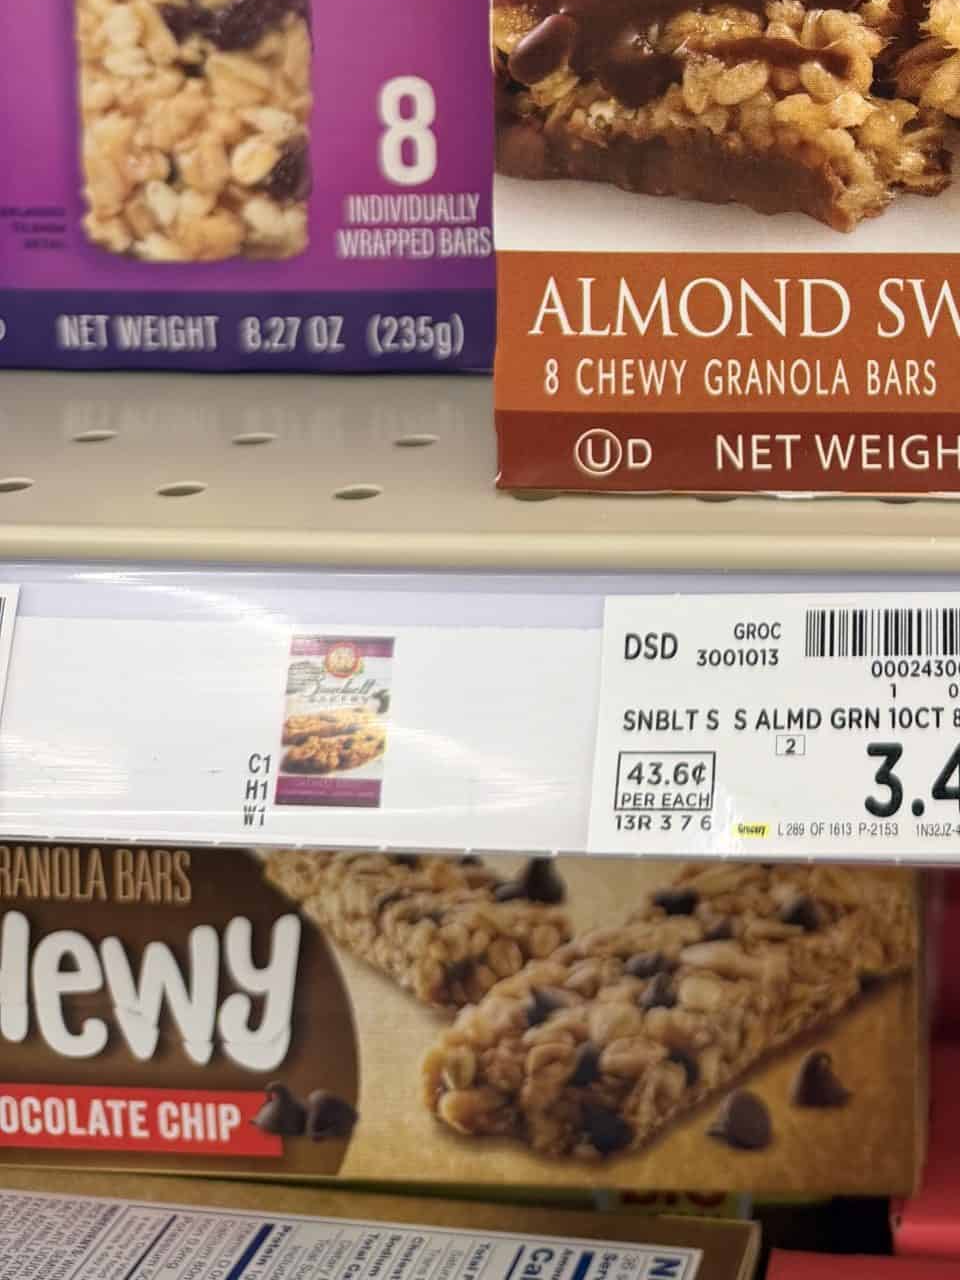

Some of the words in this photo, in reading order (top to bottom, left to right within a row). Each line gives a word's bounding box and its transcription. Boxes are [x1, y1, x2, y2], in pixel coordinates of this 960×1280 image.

[377, 75, 438, 187] 8
[348, 194, 481, 225] INDIVIDUALLY
[338, 228, 436, 257] WRAPPED
[440, 228, 492, 257] BARS
[528, 276, 852, 339] ALMOND
[57, 314, 109, 350] NET
[116, 314, 219, 353] WEIGHT
[241, 316, 303, 354] 8.27
[310, 317, 346, 353] OZ
[369, 315, 465, 357] (235g)
[544, 358, 560, 396] 8
[576, 358, 688, 396] CHEWY
[704, 358, 850, 396] GRANOLA
[866, 359, 938, 396] BARS
[716, 434, 801, 470] NET
[733, 622, 782, 640] GROC
[624, 632, 679, 661] DSD
[696, 648, 779, 667] 3001013
[623, 709, 699, 732] SNBLT
[706, 709, 720, 731] S
[734, 708, 747, 731] S
[755, 707, 822, 731] ALMD
[830, 707, 880, 730] GRN
[888, 706, 945, 729] 10CT
[785, 738, 797, 754] 2
[249, 753, 271, 774] C1
[245, 780, 268, 800] H1
[621, 793, 655, 808] PER
[661, 793, 711, 808] EACH
[615, 814, 652, 832] 13R
[660, 814, 672, 832] 3
[681, 814, 692, 831] 7
[700, 814, 712, 831] 6
[787, 824, 805, 837] 289
[810, 823, 825, 836] OF
[829, 823, 852, 836] 1613
[858, 823, 899, 837] P-2153
[116, 849, 192, 904] BARS
[157, 1101, 242, 1142] CHIP
